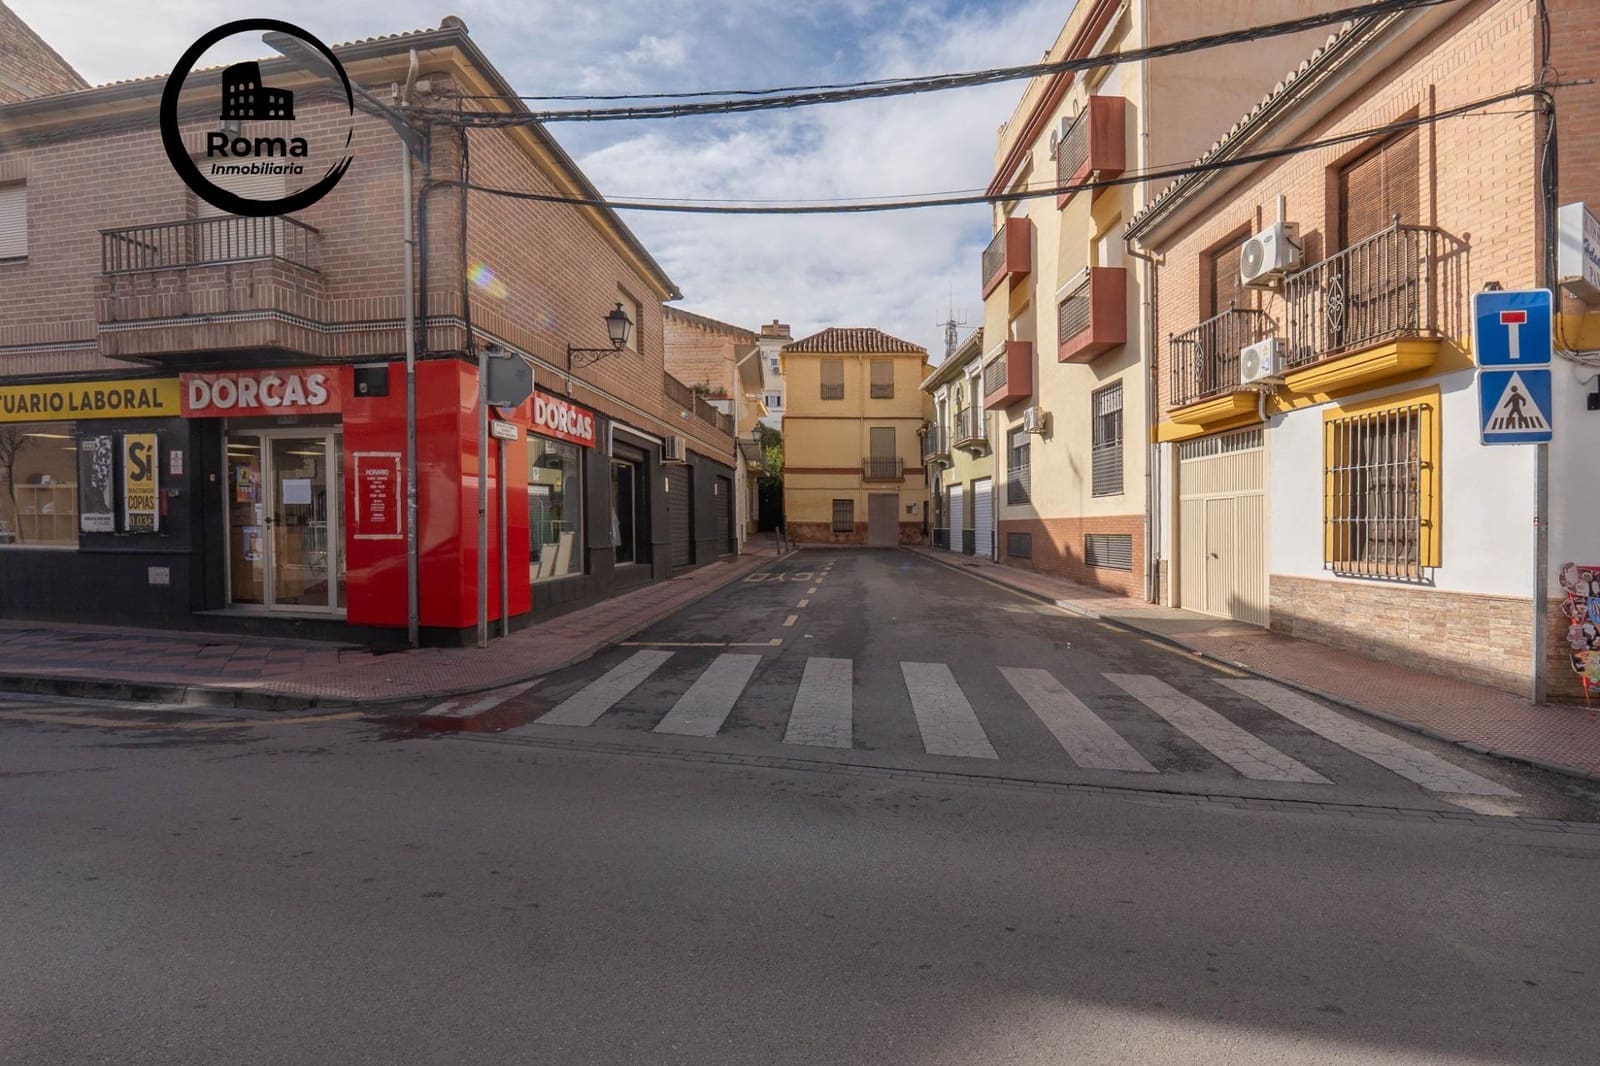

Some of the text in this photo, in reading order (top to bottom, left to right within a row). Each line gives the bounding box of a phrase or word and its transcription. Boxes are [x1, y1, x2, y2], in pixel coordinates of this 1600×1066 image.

[69, 387, 164, 412] LABORAL
[188, 373, 329, 410] DORCAS
[534, 397, 593, 440] DORCAS
[129, 441, 153, 482] Sí
[128, 495, 155, 509] COPIAS
